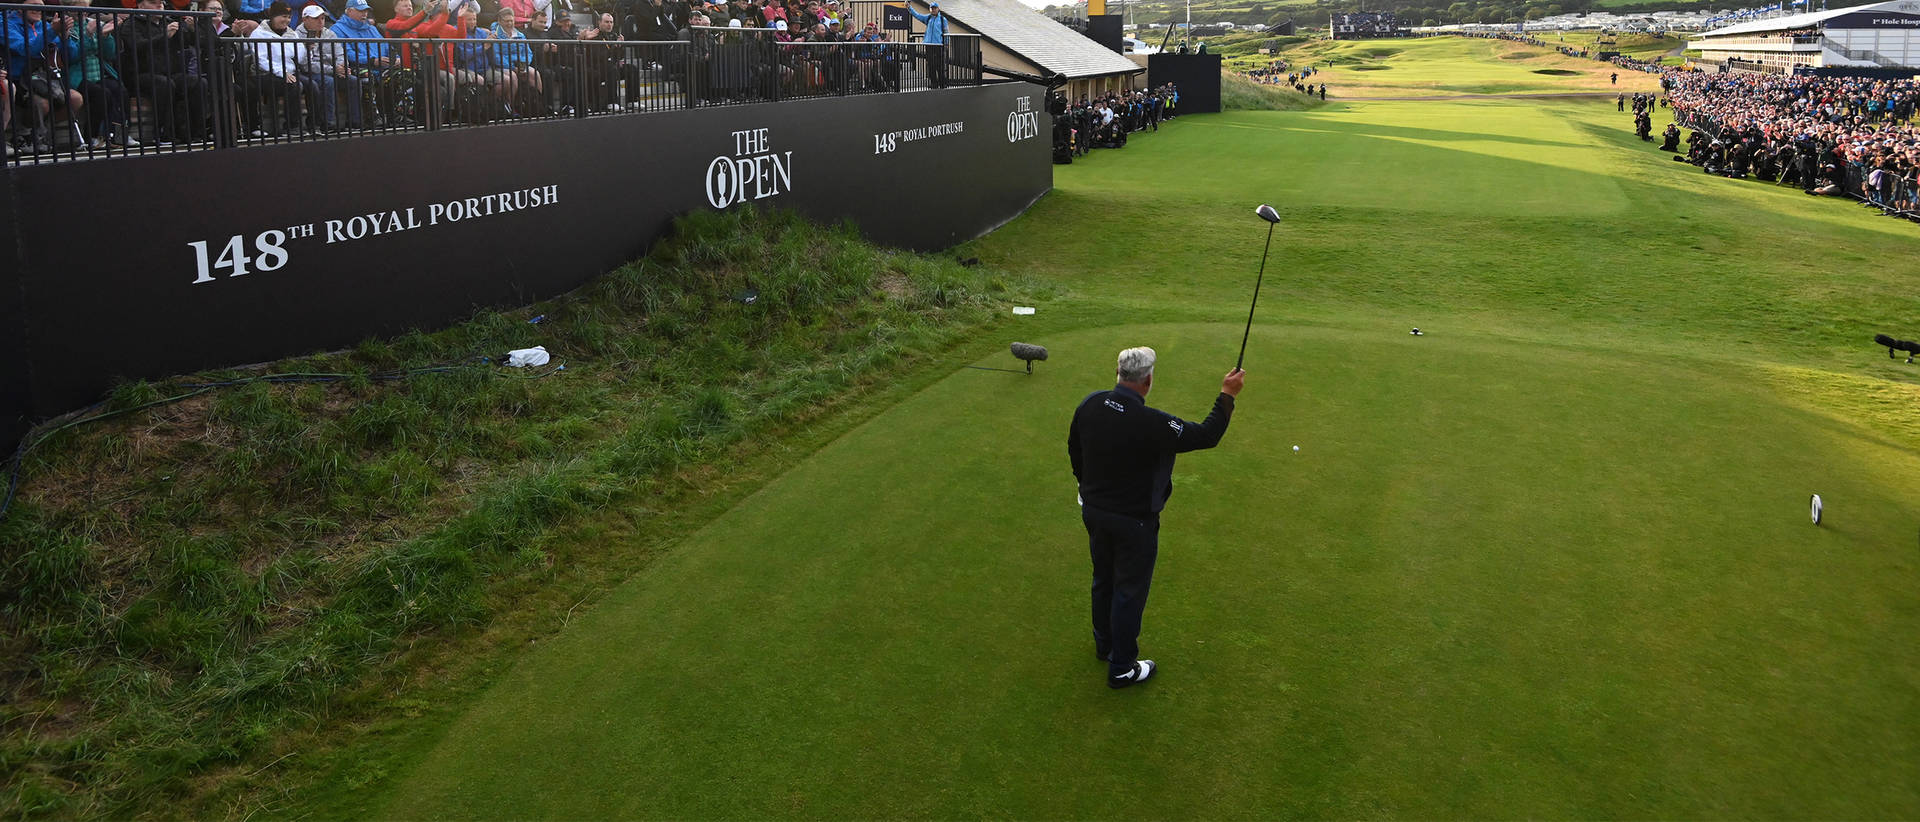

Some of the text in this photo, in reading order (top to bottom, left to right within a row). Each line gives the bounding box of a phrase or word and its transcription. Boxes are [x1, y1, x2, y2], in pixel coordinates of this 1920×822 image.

[1016, 95, 1031, 112] THE
[731, 127, 770, 156] THE
[874, 121, 964, 154] 148TH ROYAL PORTRUSH
[1007, 111, 1039, 143] OPEN
[705, 151, 793, 209] OPEN
[187, 184, 559, 284] 148TH ROYAL PORTRUSH
